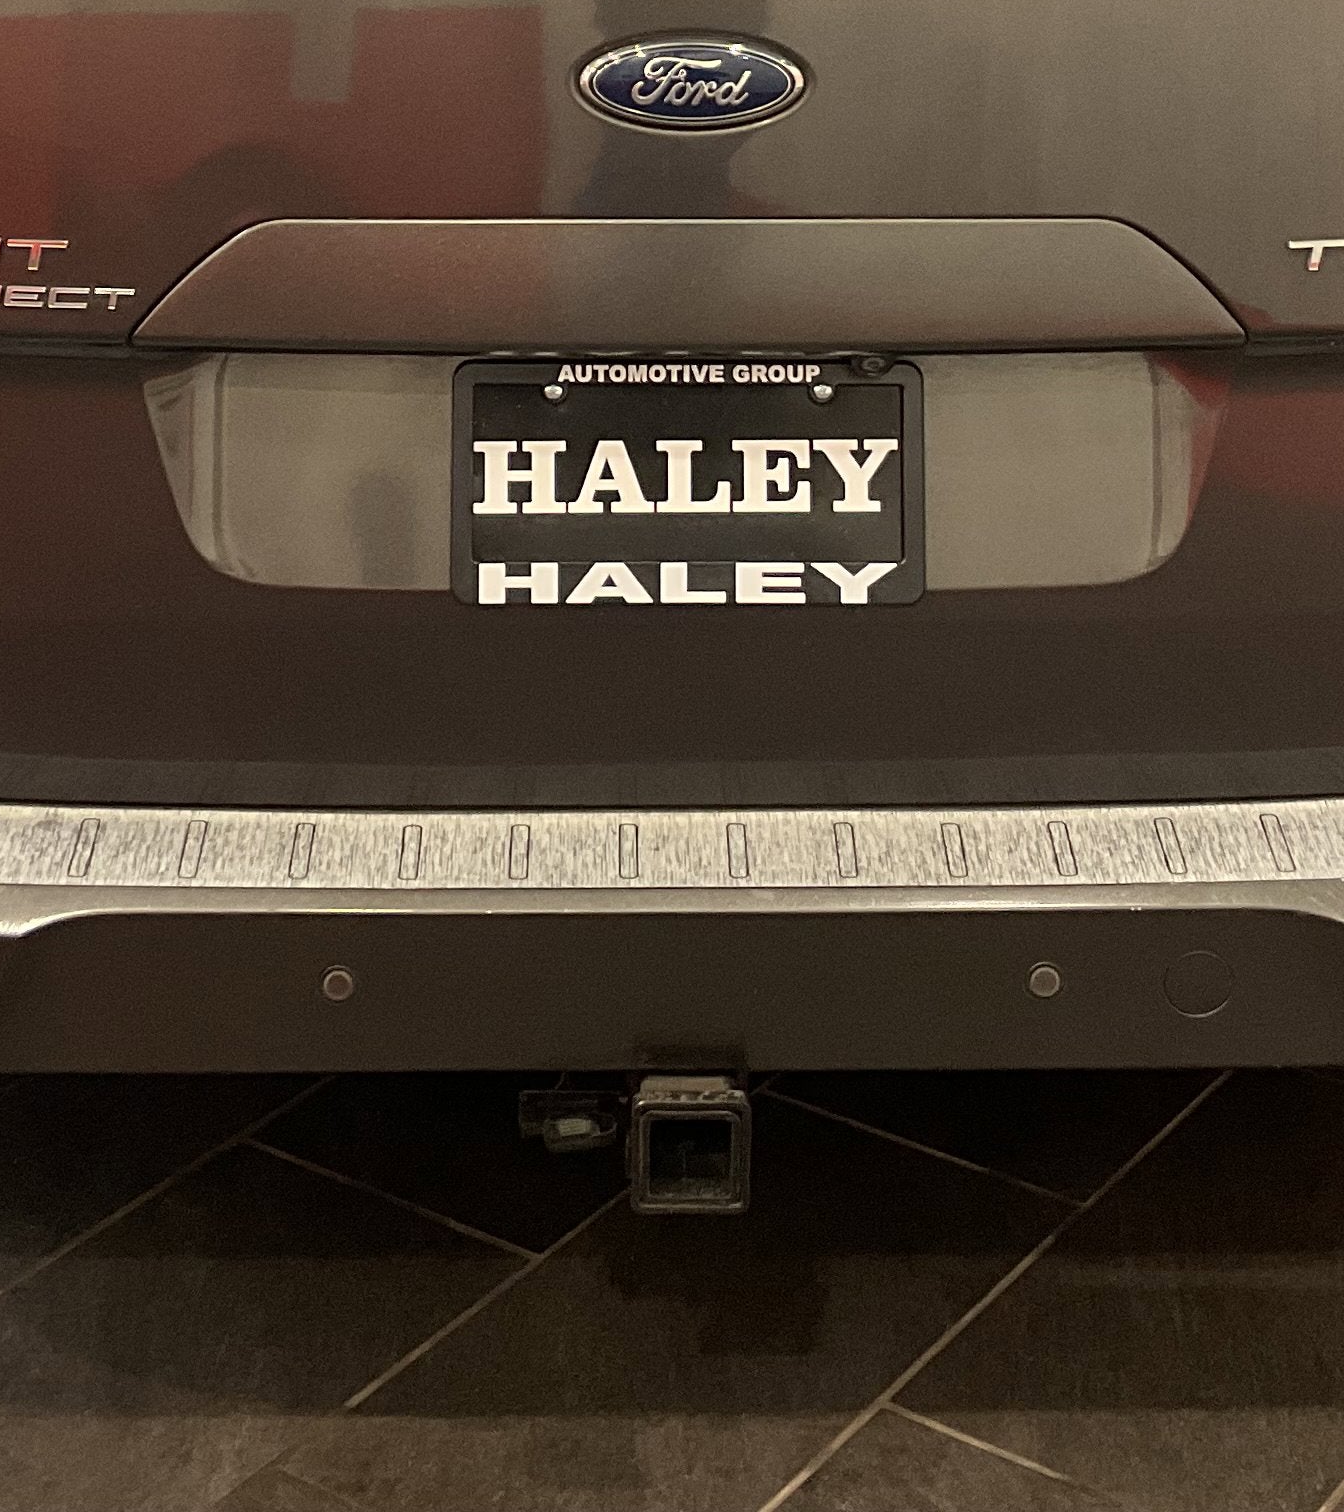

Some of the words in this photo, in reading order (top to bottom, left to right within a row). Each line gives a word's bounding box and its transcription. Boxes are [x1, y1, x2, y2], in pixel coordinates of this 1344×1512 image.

[631, 56, 752, 107] Ford
[557, 364, 725, 383] AUTOMOTIVE
[732, 364, 821, 383] GROUP
[472, 438, 899, 515] HALEY
[478, 561, 898, 605] HALEY
